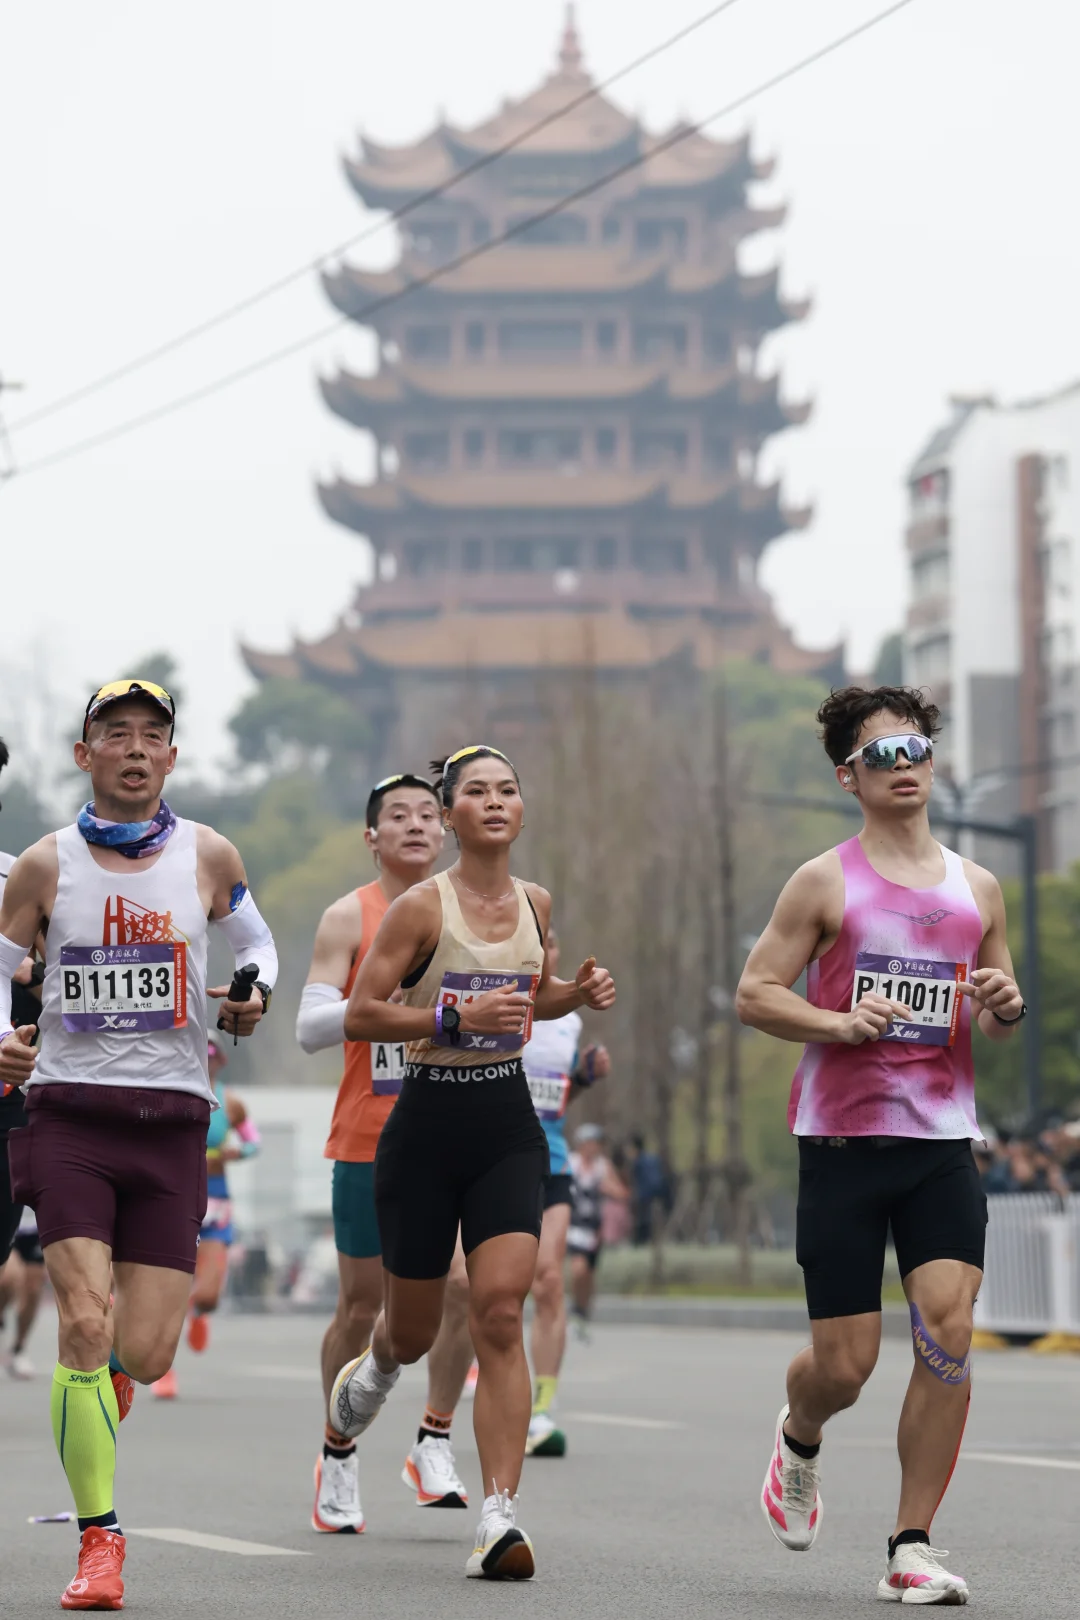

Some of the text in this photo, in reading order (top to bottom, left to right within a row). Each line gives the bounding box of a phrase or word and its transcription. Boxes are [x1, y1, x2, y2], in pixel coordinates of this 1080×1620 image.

[107, 948, 140, 958] 中国银行
[904, 962, 934, 973] 中国银行
[64, 970, 82, 1000] B
[88, 967, 170, 1000] 11133
[882, 980, 950, 1014] 10011
[376, 1044, 388, 1068] A
[428, 1062, 518, 1083] SAUCONY
[69, 1372, 100, 1383] SPORTS
